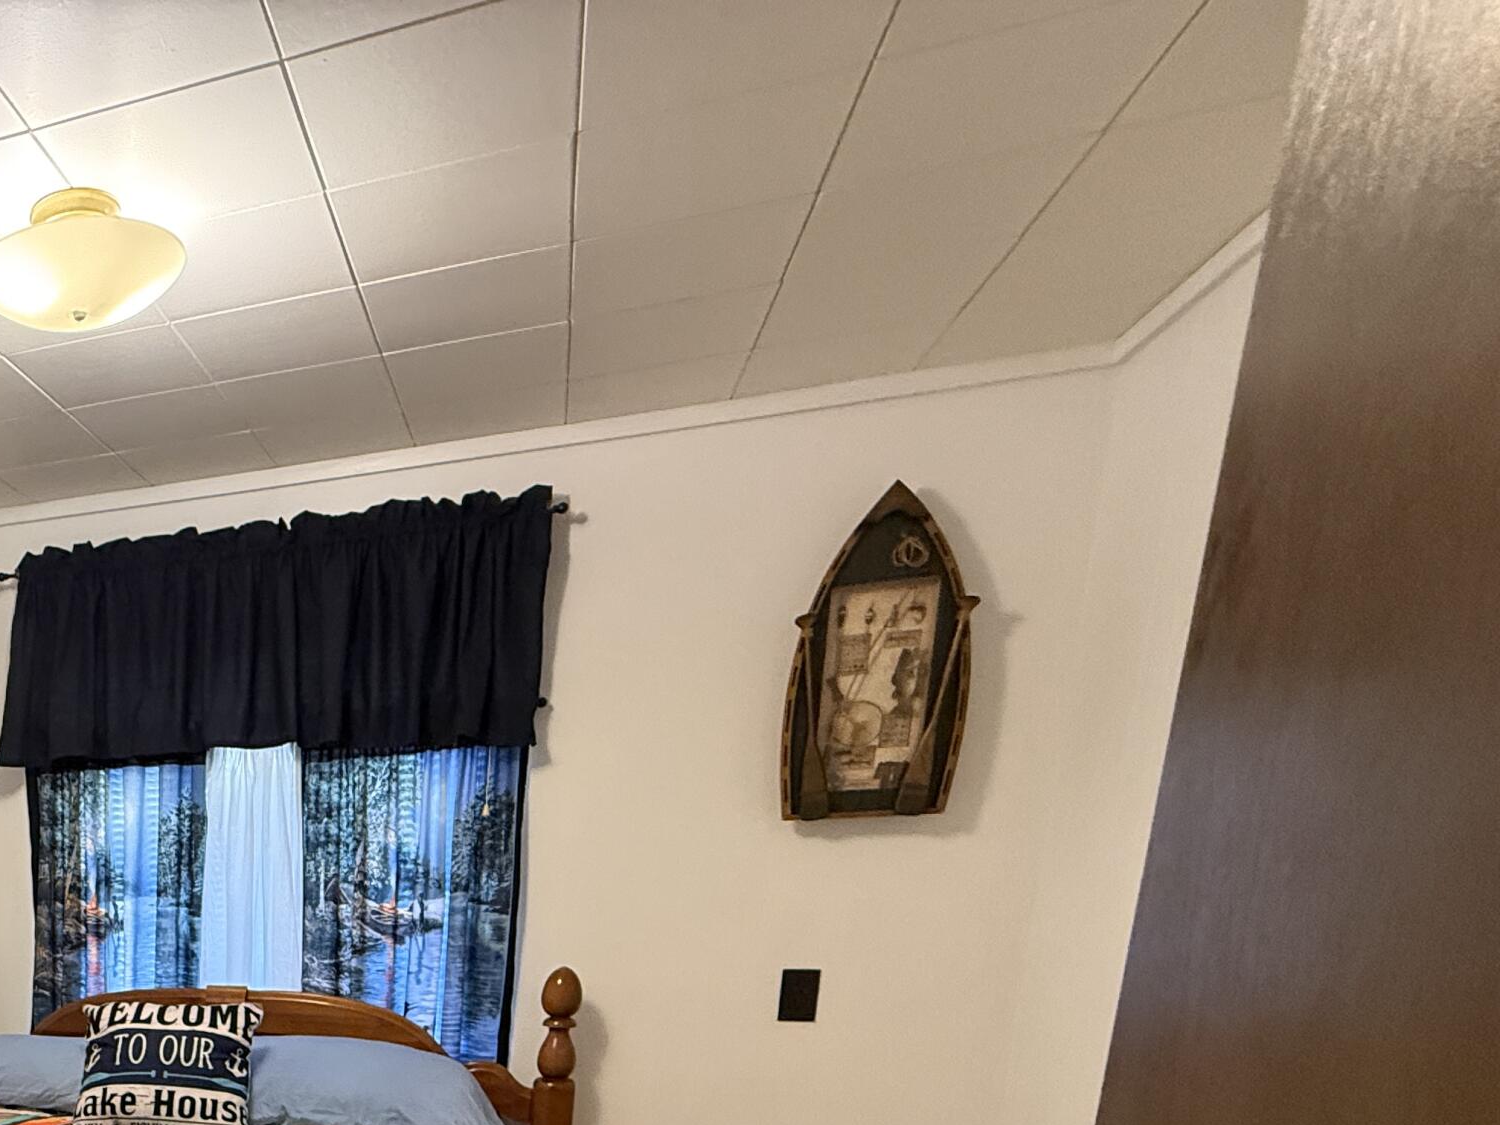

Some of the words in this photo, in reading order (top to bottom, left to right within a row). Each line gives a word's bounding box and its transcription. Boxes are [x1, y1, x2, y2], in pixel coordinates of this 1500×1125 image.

[85, 1002, 261, 1045] WELCOME
[113, 1032, 148, 1066] TO
[158, 1033, 214, 1071] OUR
